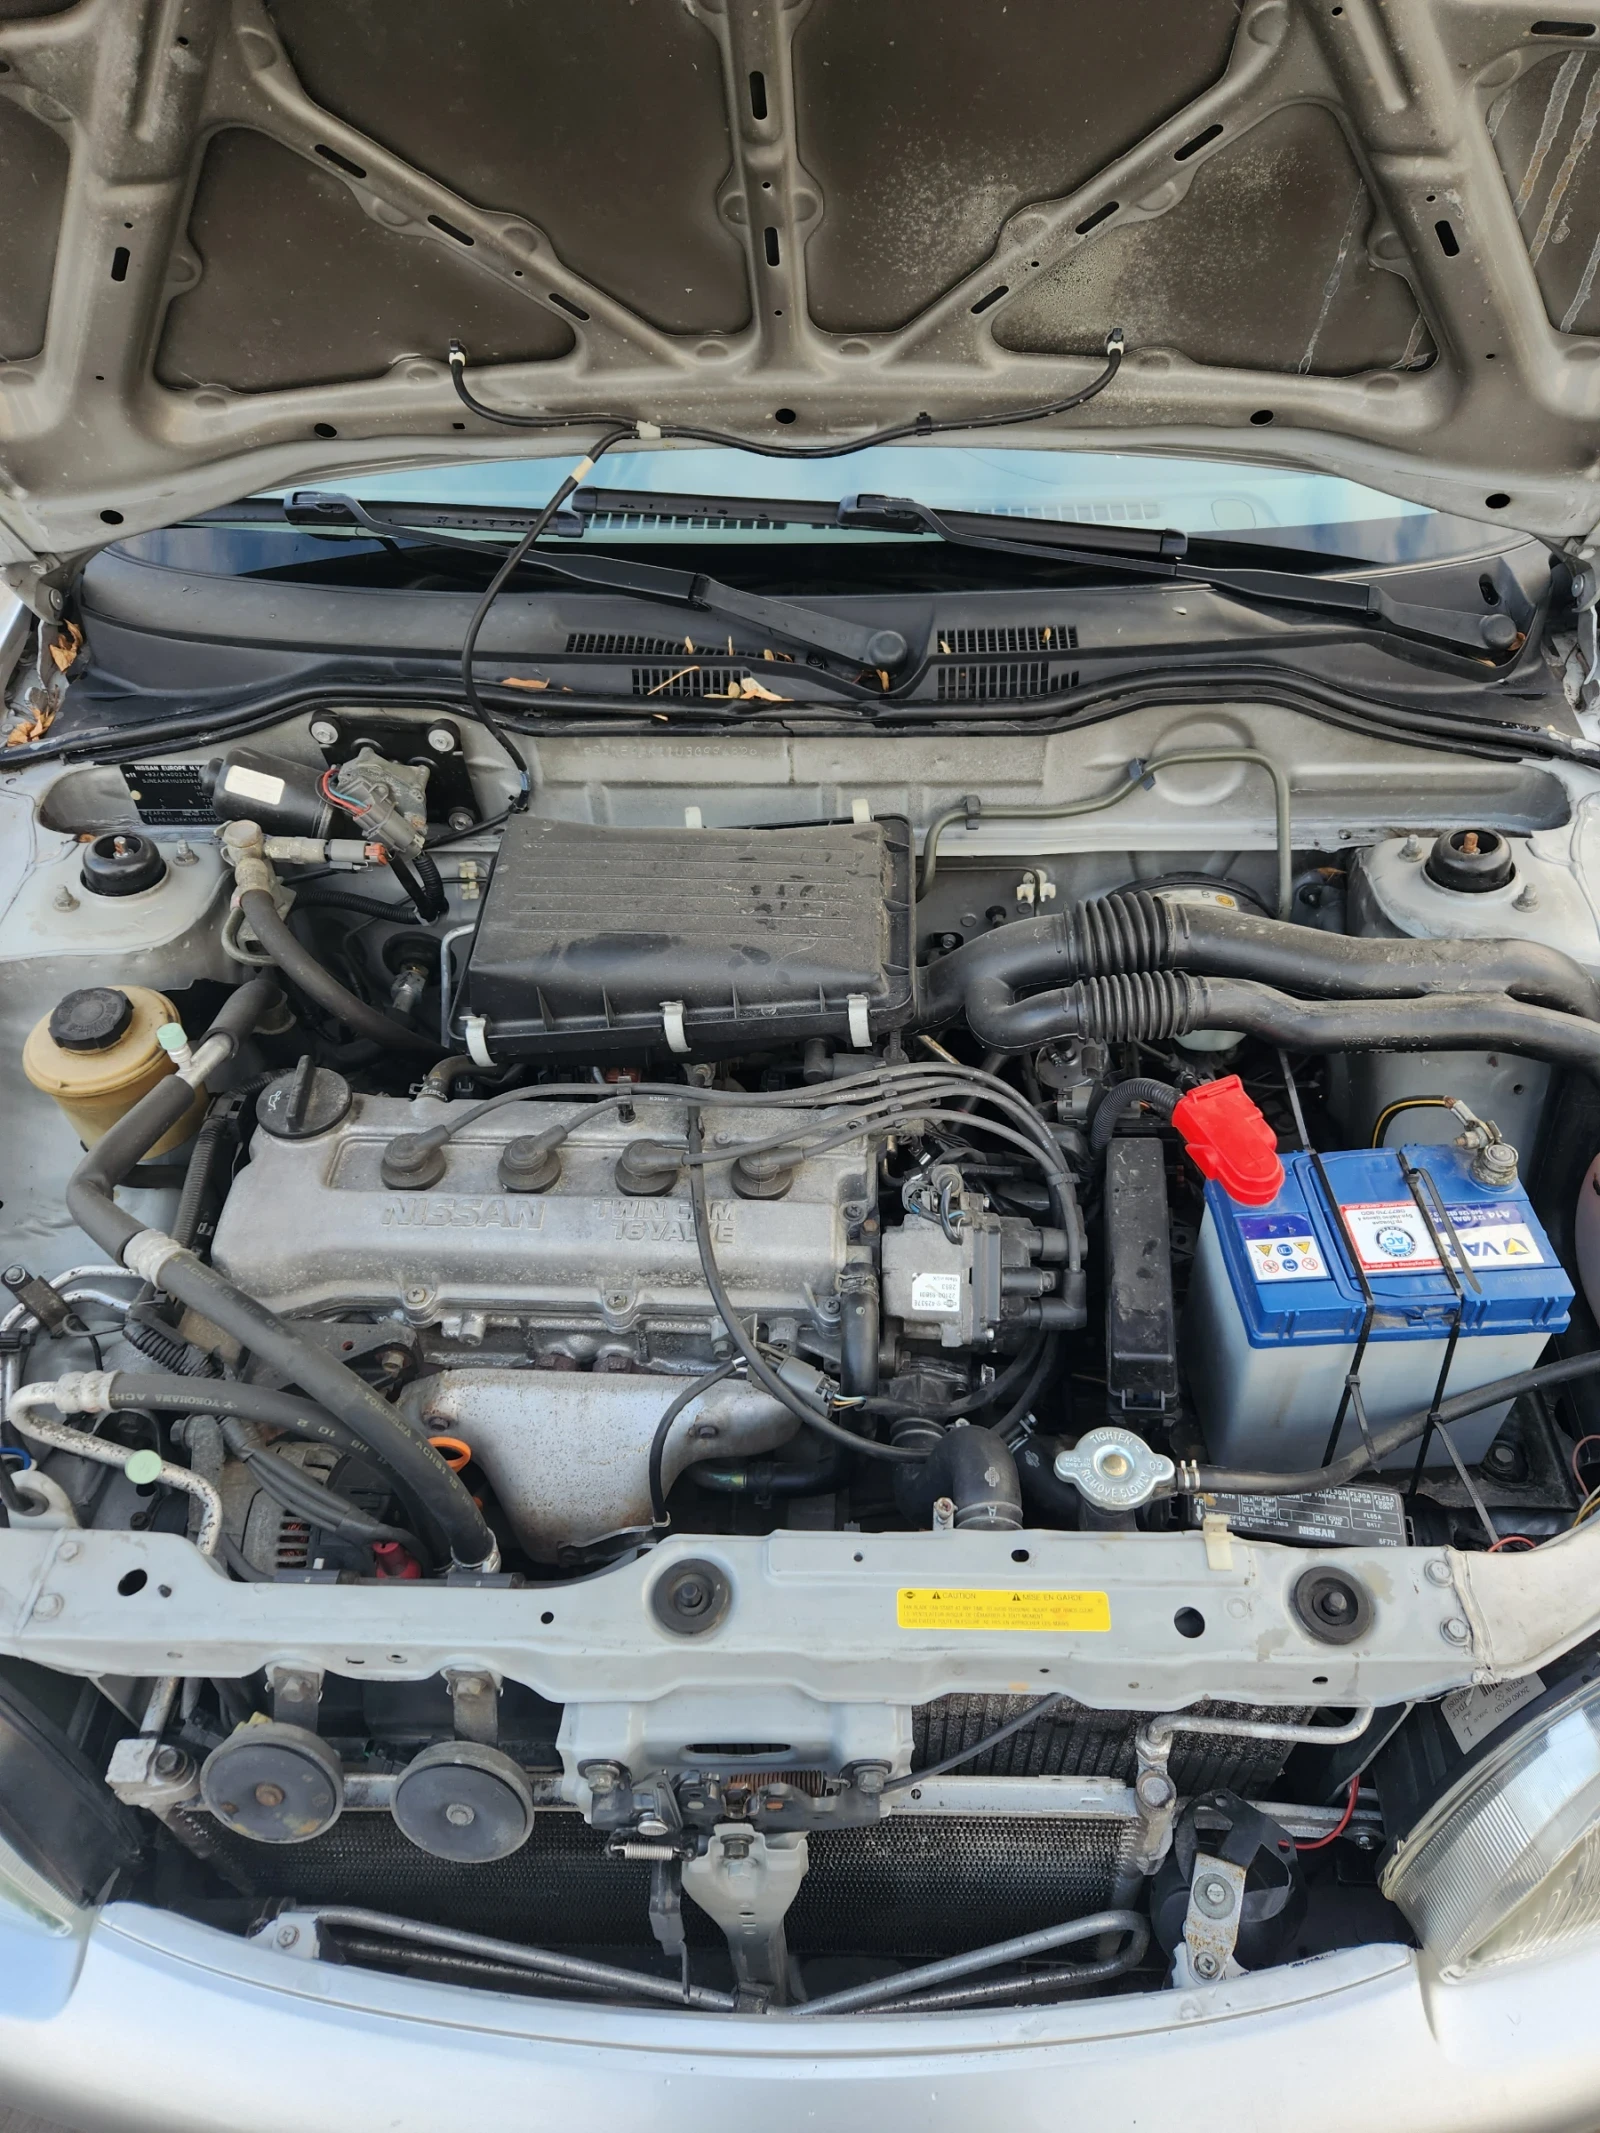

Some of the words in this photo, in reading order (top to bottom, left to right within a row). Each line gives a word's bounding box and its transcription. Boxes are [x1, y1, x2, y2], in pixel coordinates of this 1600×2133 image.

[381, 1197, 547, 1231] NISSAN
[593, 1198, 667, 1221] TWIN
[674, 1201, 737, 1222] CM
[1487, 1209, 1511, 1219] A14
[155, 1393, 220, 1407] YOKOHAMA
[364, 1393, 412, 1438] YOKOHAMA
[1089, 1431, 1134, 1446] TIGHTEN
[1081, 1468, 1117, 1498] REMOVE
[1120, 1471, 1152, 1498] SLOWLY
[1298, 1525, 1337, 1539] NISSAN
[942, 1591, 976, 1600] CAUTION
[1022, 1593, 1041, 1601] MISE
[1043, 1593, 1055, 1601] EN
[1056, 1593, 1084, 1602] GARDE
[1463, 1726, 1473, 1737] L
